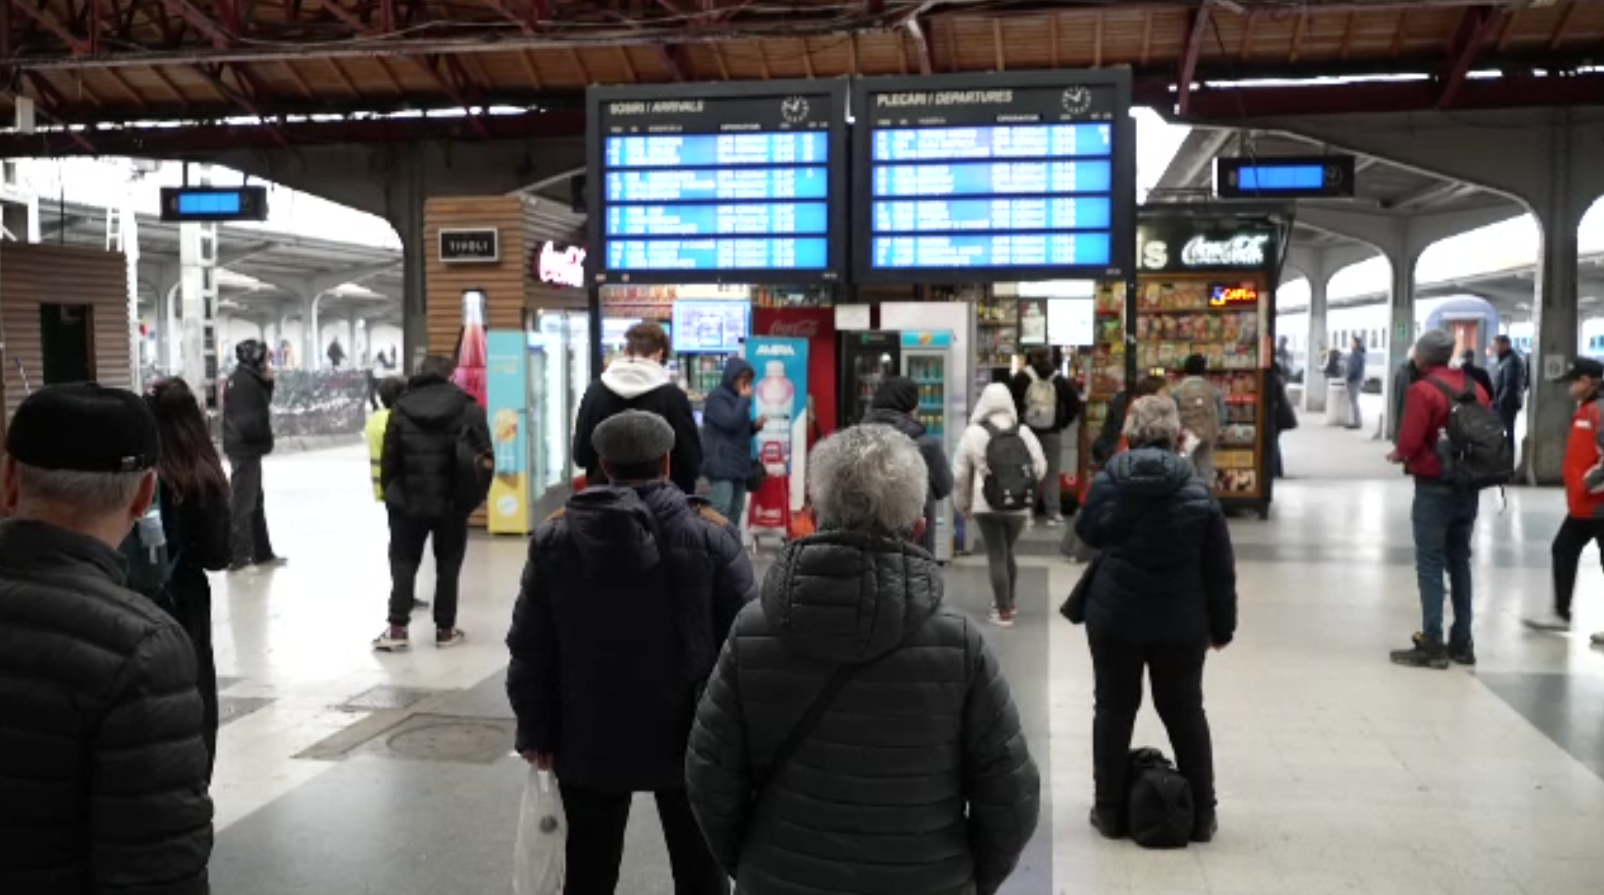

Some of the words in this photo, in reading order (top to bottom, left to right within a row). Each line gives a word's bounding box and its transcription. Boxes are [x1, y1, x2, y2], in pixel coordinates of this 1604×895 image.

[934, 89, 1013, 105] DEPARTURES
[651, 99, 704, 113] ARRIVALS
[449, 240, 489, 252] TIVOLI
